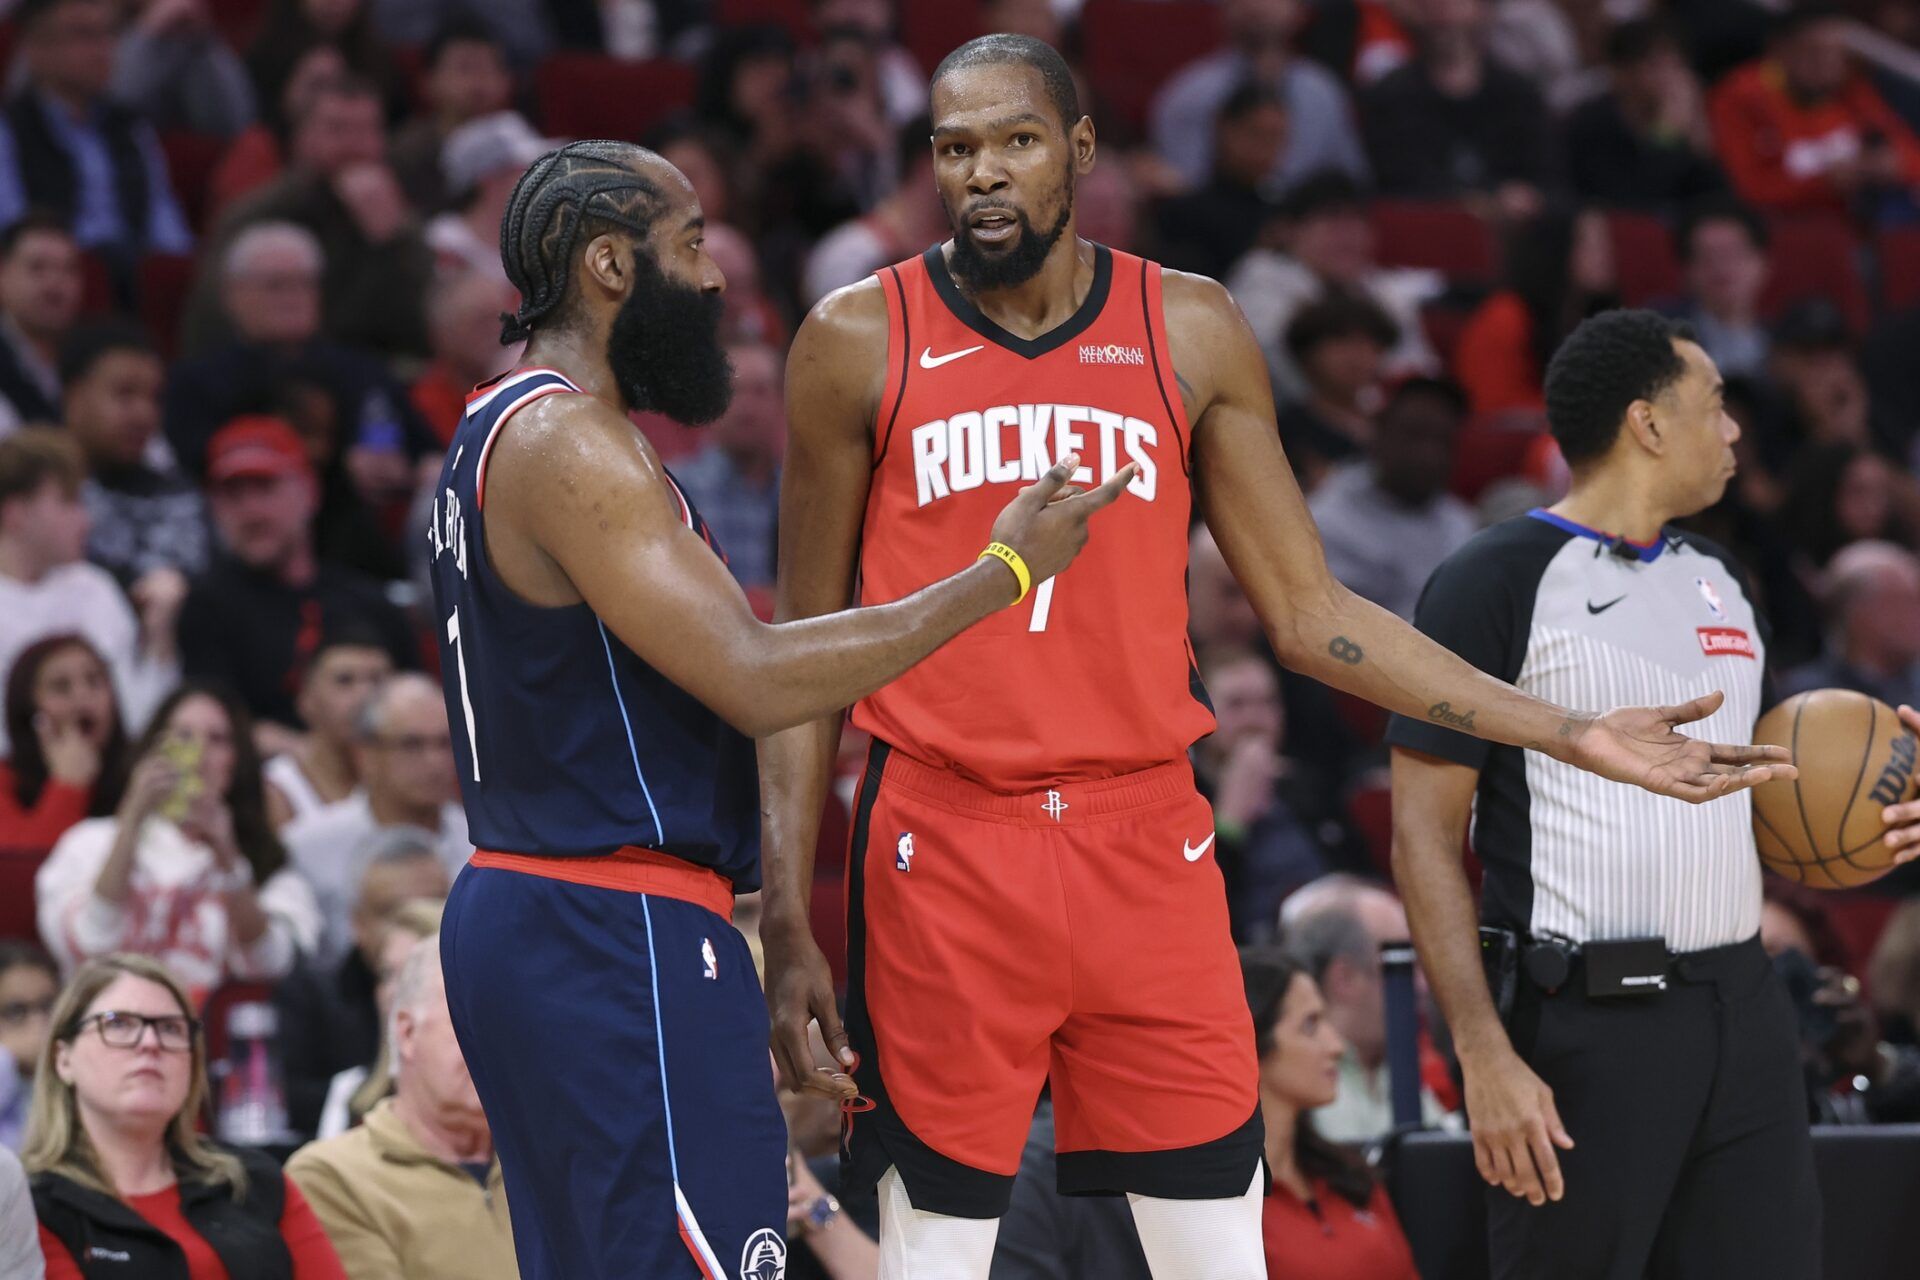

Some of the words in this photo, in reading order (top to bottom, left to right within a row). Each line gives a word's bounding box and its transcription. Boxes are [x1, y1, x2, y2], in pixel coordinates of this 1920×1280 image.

[1079, 344, 1143, 357] MEMORIAL
[1080, 354, 1144, 365] HERMANN
[911, 403, 1158, 508] ROCKETS
[1428, 701, 1477, 731] Owls
[1868, 734, 1917, 807] Wils
